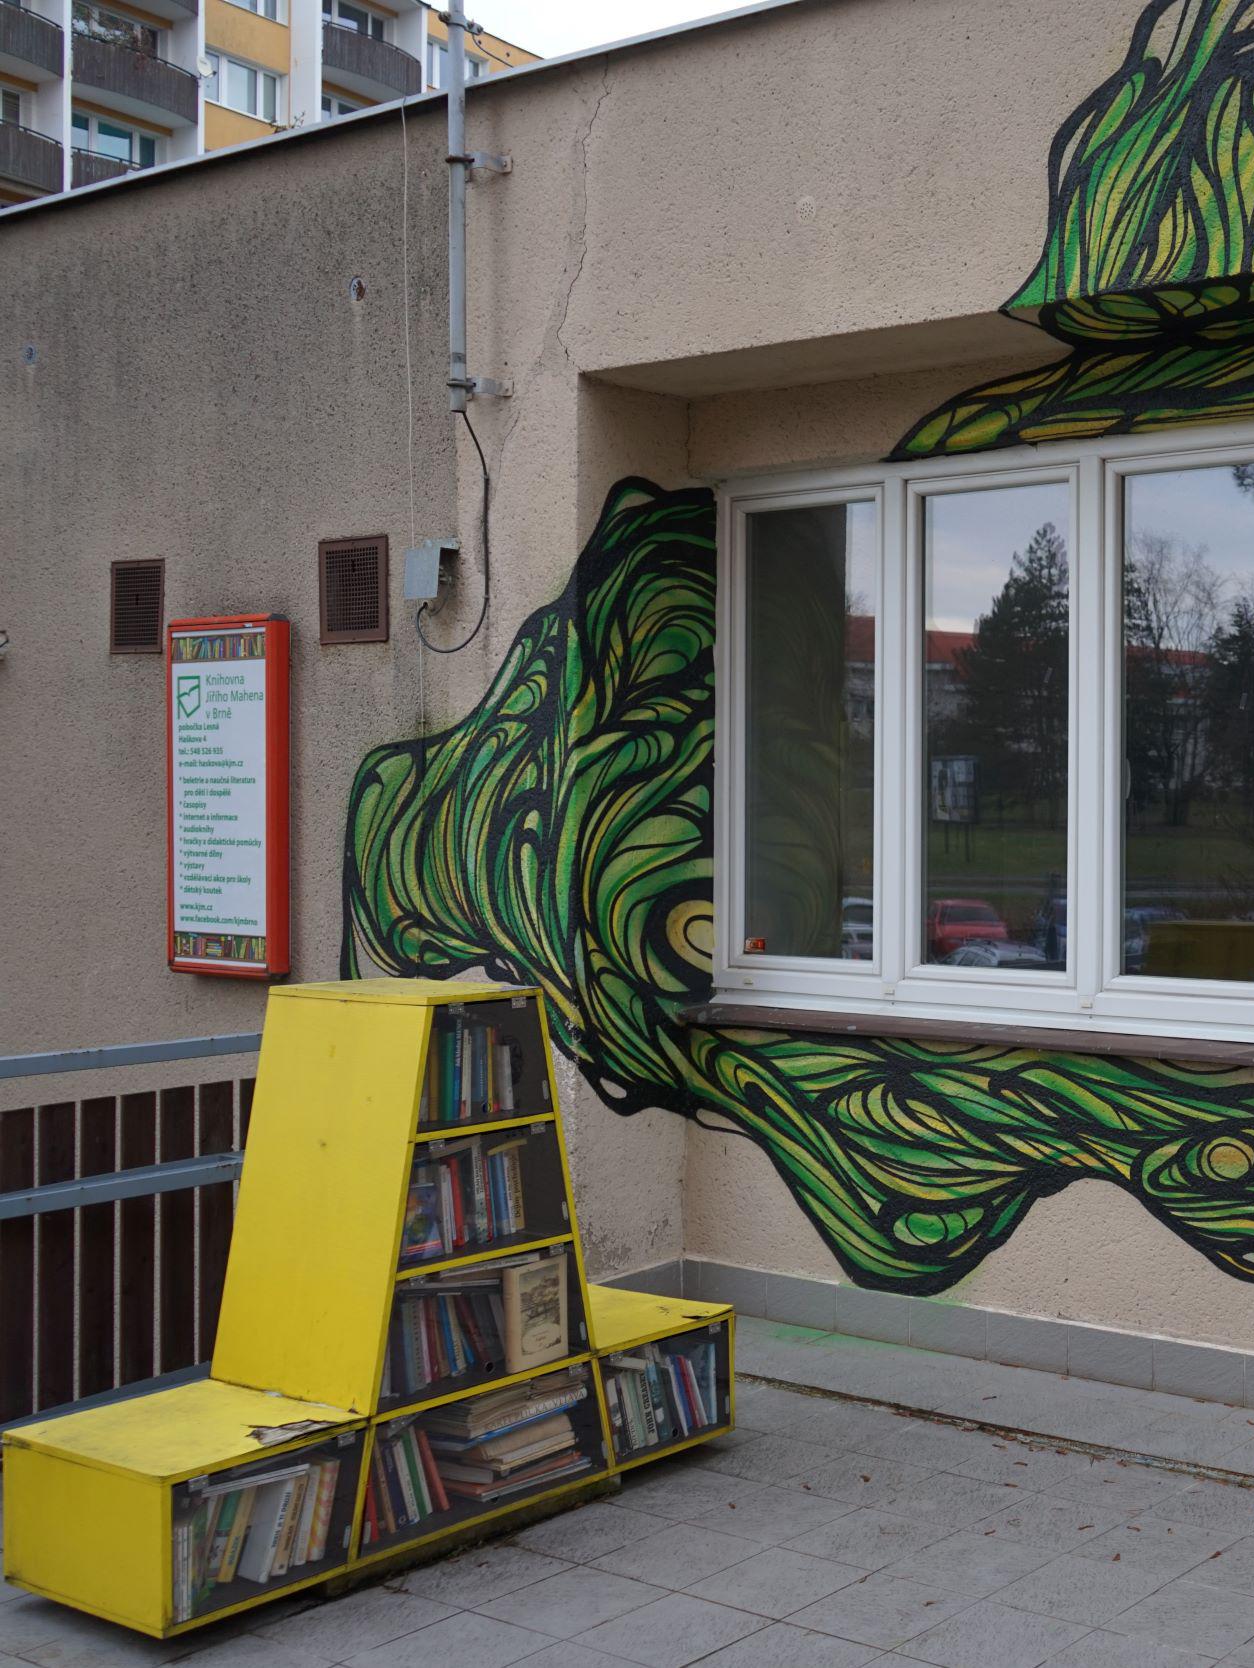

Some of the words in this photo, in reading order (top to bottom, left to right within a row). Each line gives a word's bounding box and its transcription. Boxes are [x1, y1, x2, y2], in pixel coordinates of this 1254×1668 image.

[205, 673, 245, 686] Knihovna
[205, 690, 229, 703] Jiřího
[230, 690, 264, 702] Mahena
[205, 710, 211, 719] v
[212, 707, 232, 719] Brně
[178, 723, 203, 732] pobočka
[183, 776, 204, 784] beletrie
[209, 776, 230, 784] naučná
[230, 776, 256, 784] literatura
[184, 790, 194, 798] pro
[209, 788, 231, 798] dospělé
[183, 801, 207, 810] časopisy
[183, 812, 206, 820] internet
[210, 812, 238, 821] informace
[183, 825, 214, 834] audioknihy
[183, 837, 202, 846] hračky
[207, 837, 236, 846] didaktické
[236, 839, 261, 848] pomůcky
[183, 849, 208, 858] výtvarné
[208, 849, 223, 859] dílny
[183, 862, 205, 871] výstavy
[183, 873, 212, 882] vzdělávací
[226, 876, 236, 884] pro
[237, 875, 251, 885] školy
[183, 885, 202, 895] dětský
[203, 886, 223, 895] koutek
[179, 902, 213, 912] www.kjm.cz
[645, 1411, 655, 1434] JOHN
